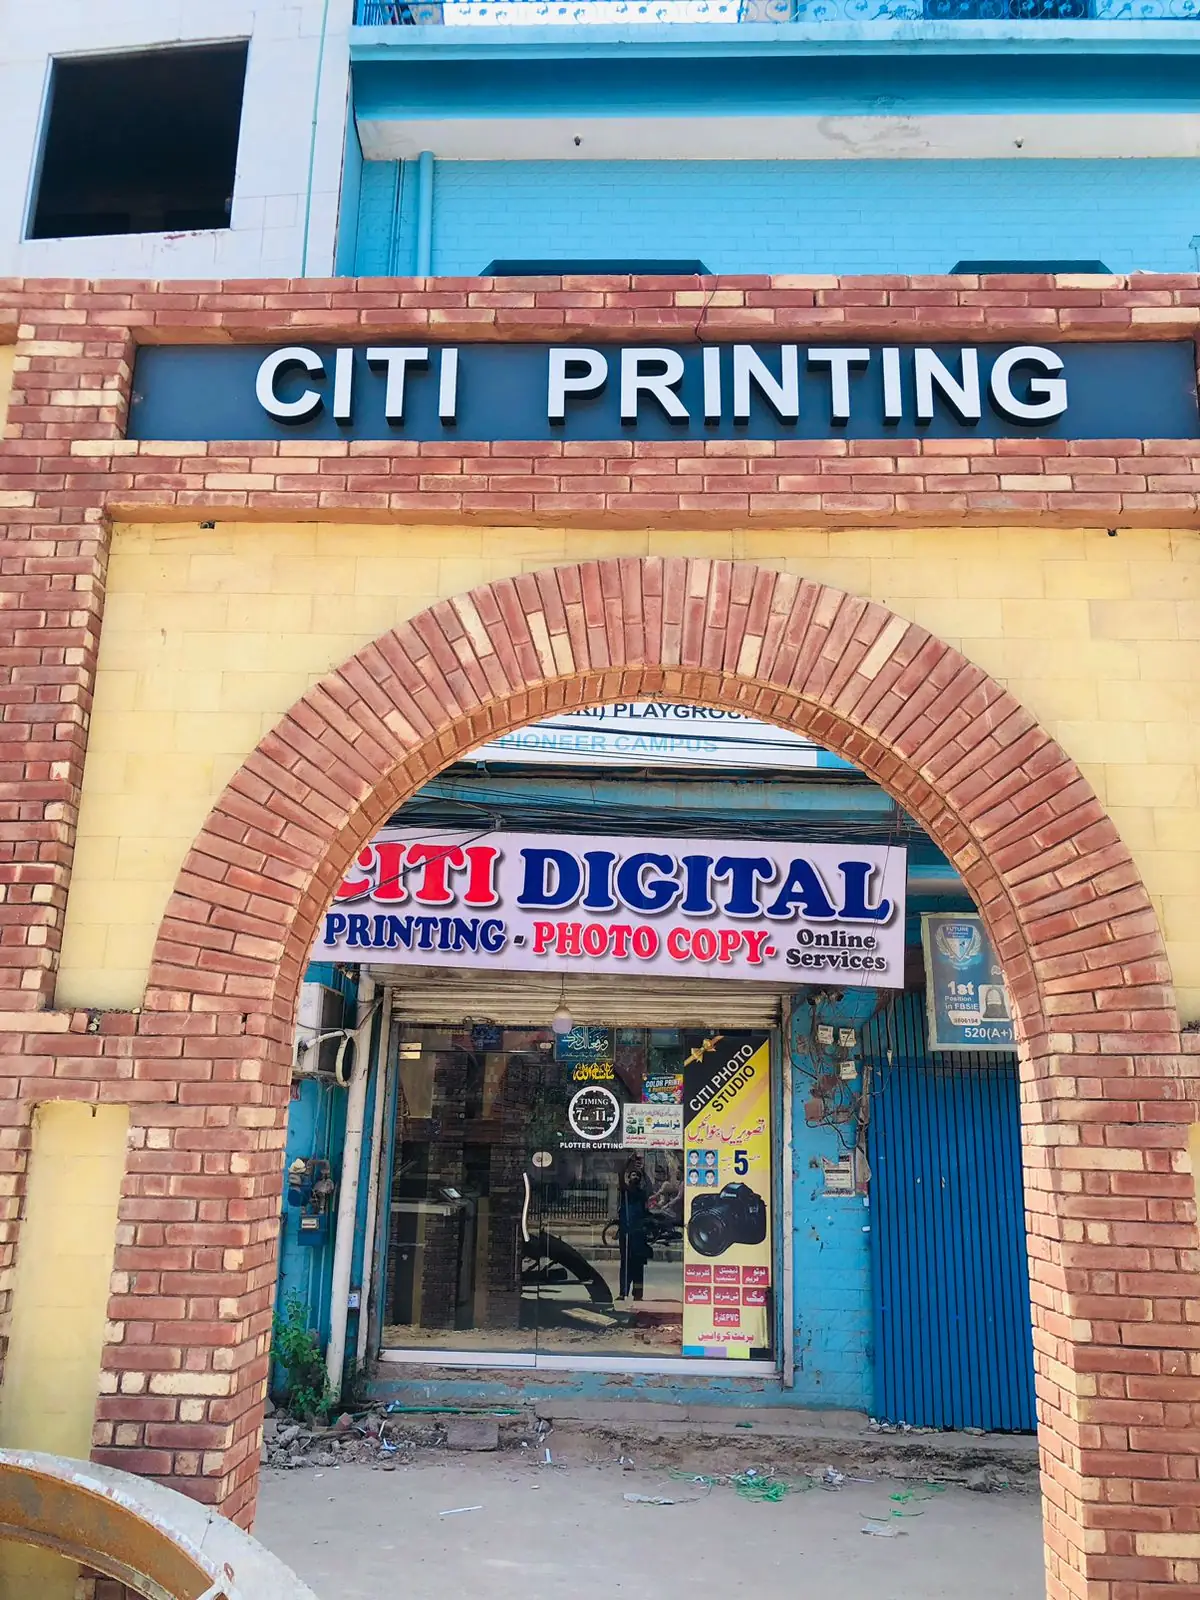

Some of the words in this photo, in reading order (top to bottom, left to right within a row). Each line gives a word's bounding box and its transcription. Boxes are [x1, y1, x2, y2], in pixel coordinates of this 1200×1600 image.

[255, 345, 459, 420] CITI
[547, 344, 1070, 421] PRINTING
[614, 735, 719, 753] CAMPUS
[335, 842, 497, 903] CITI
[516, 847, 891, 920] DIGITAL
[323, 912, 506, 952] PRINTING
[533, 920, 659, 958] PHOTO
[796, 928, 876, 949] Online
[786, 948, 886, 970] Services
[947, 981, 974, 995] 1st
[945, 1002, 953, 1010] in
[964, 1027, 1013, 1041] 520(A+)
[645, 1080, 663, 1088] COLOR
[664, 1079, 680, 1087] PRINT
[689, 1085, 715, 1112] CITI
[711, 1044, 754, 1090] PHOTO
[711, 1065, 756, 1112] STUDIO
[734, 1149, 749, 1176] 5
[726, 1312, 740, 1322] PVC
